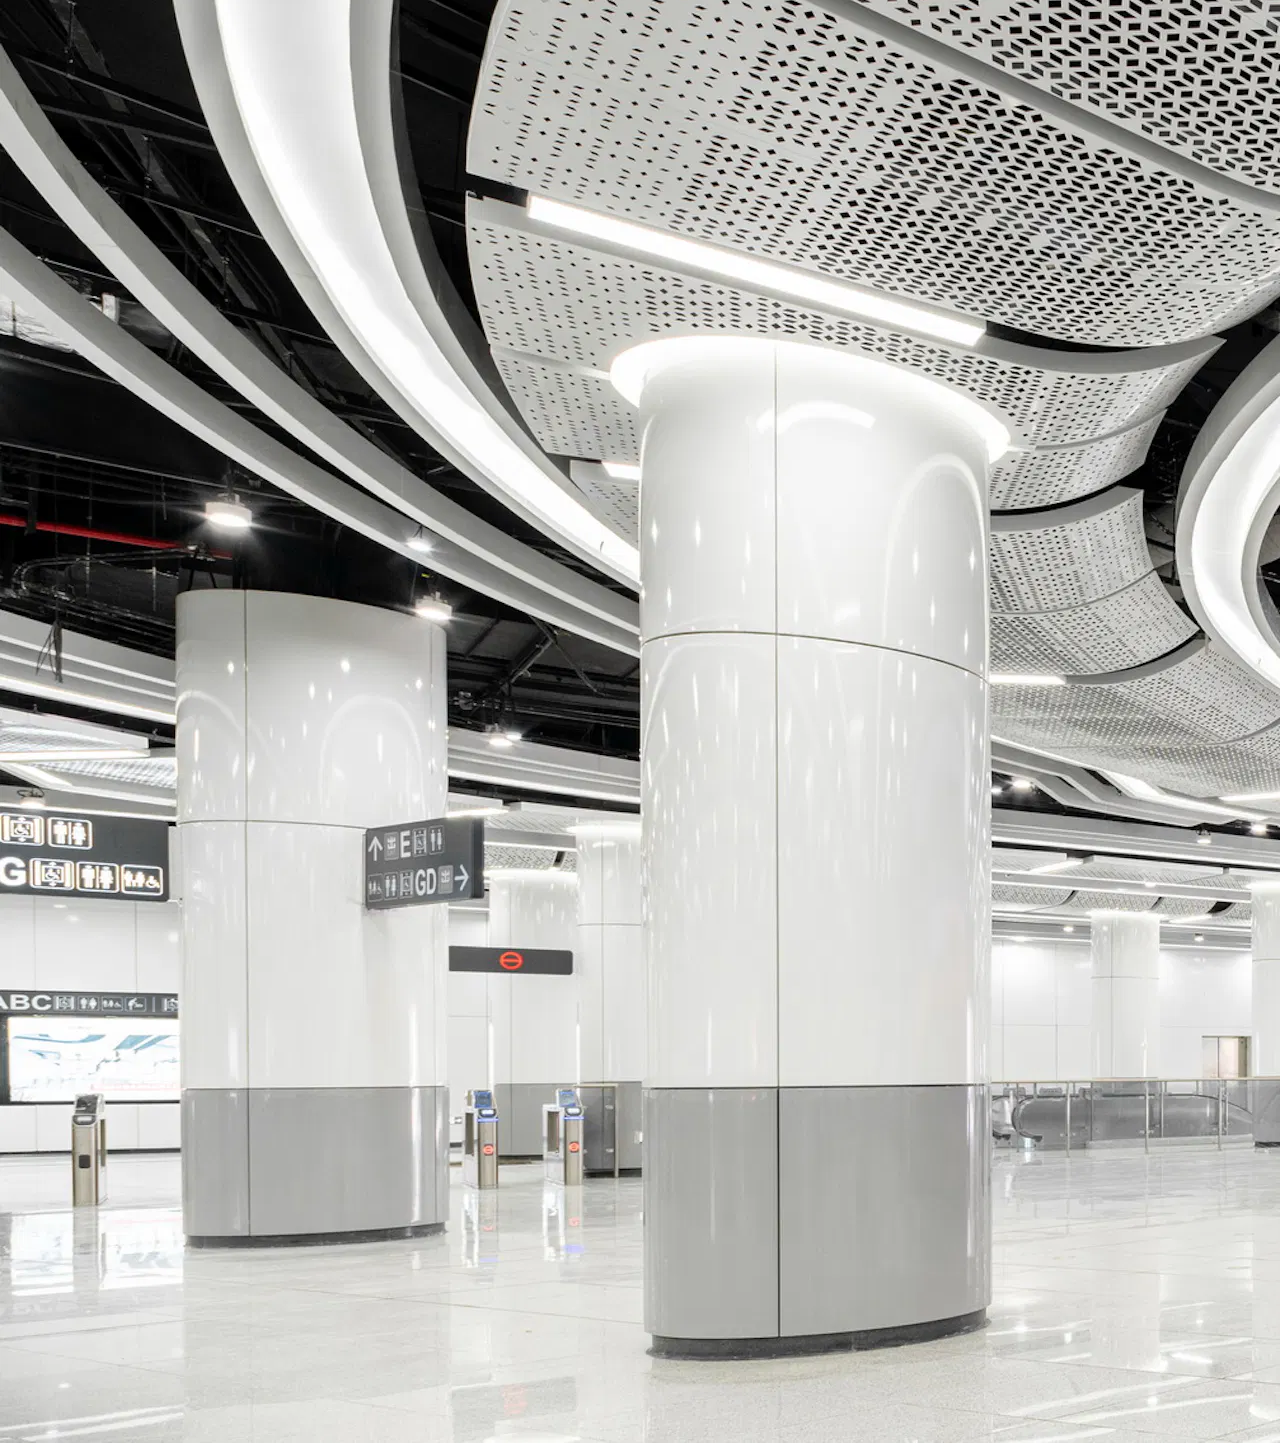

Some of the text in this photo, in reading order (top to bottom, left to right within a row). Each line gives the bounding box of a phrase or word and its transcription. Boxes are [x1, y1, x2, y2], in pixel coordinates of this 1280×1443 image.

[400, 830, 412, 858] E
[0, 856, 27, 886] G
[415, 868, 437, 896] GD
